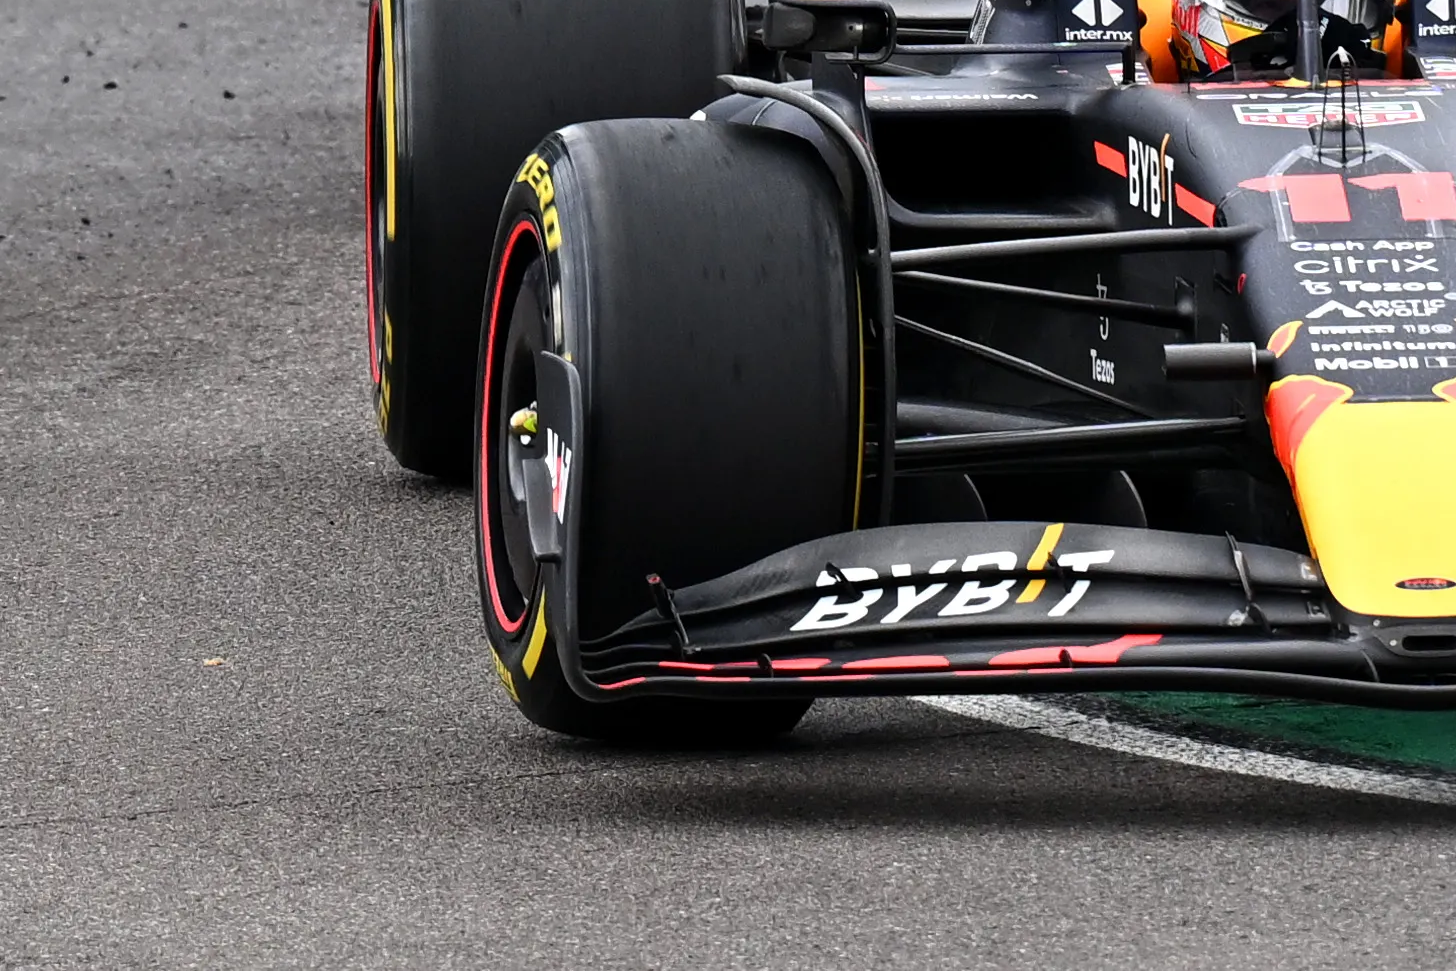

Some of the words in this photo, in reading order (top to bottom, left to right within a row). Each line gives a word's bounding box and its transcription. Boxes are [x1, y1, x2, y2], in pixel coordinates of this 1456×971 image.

[1065, 28, 1133, 41] inter.mx
[1128, 133, 1175, 226] BYBIT
[516, 153, 562, 253] ZERO
[1290, 241, 1365, 251] Cash
[1373, 240, 1434, 251] App
[1338, 280, 1445, 292] Tezos
[1355, 299, 1446, 309] ARCTIC
[1368, 308, 1439, 317] WOLF
[1090, 348, 1116, 386] Tezos
[1314, 356, 1420, 371] Mobil
[790, 522, 1115, 632] BYBIT
